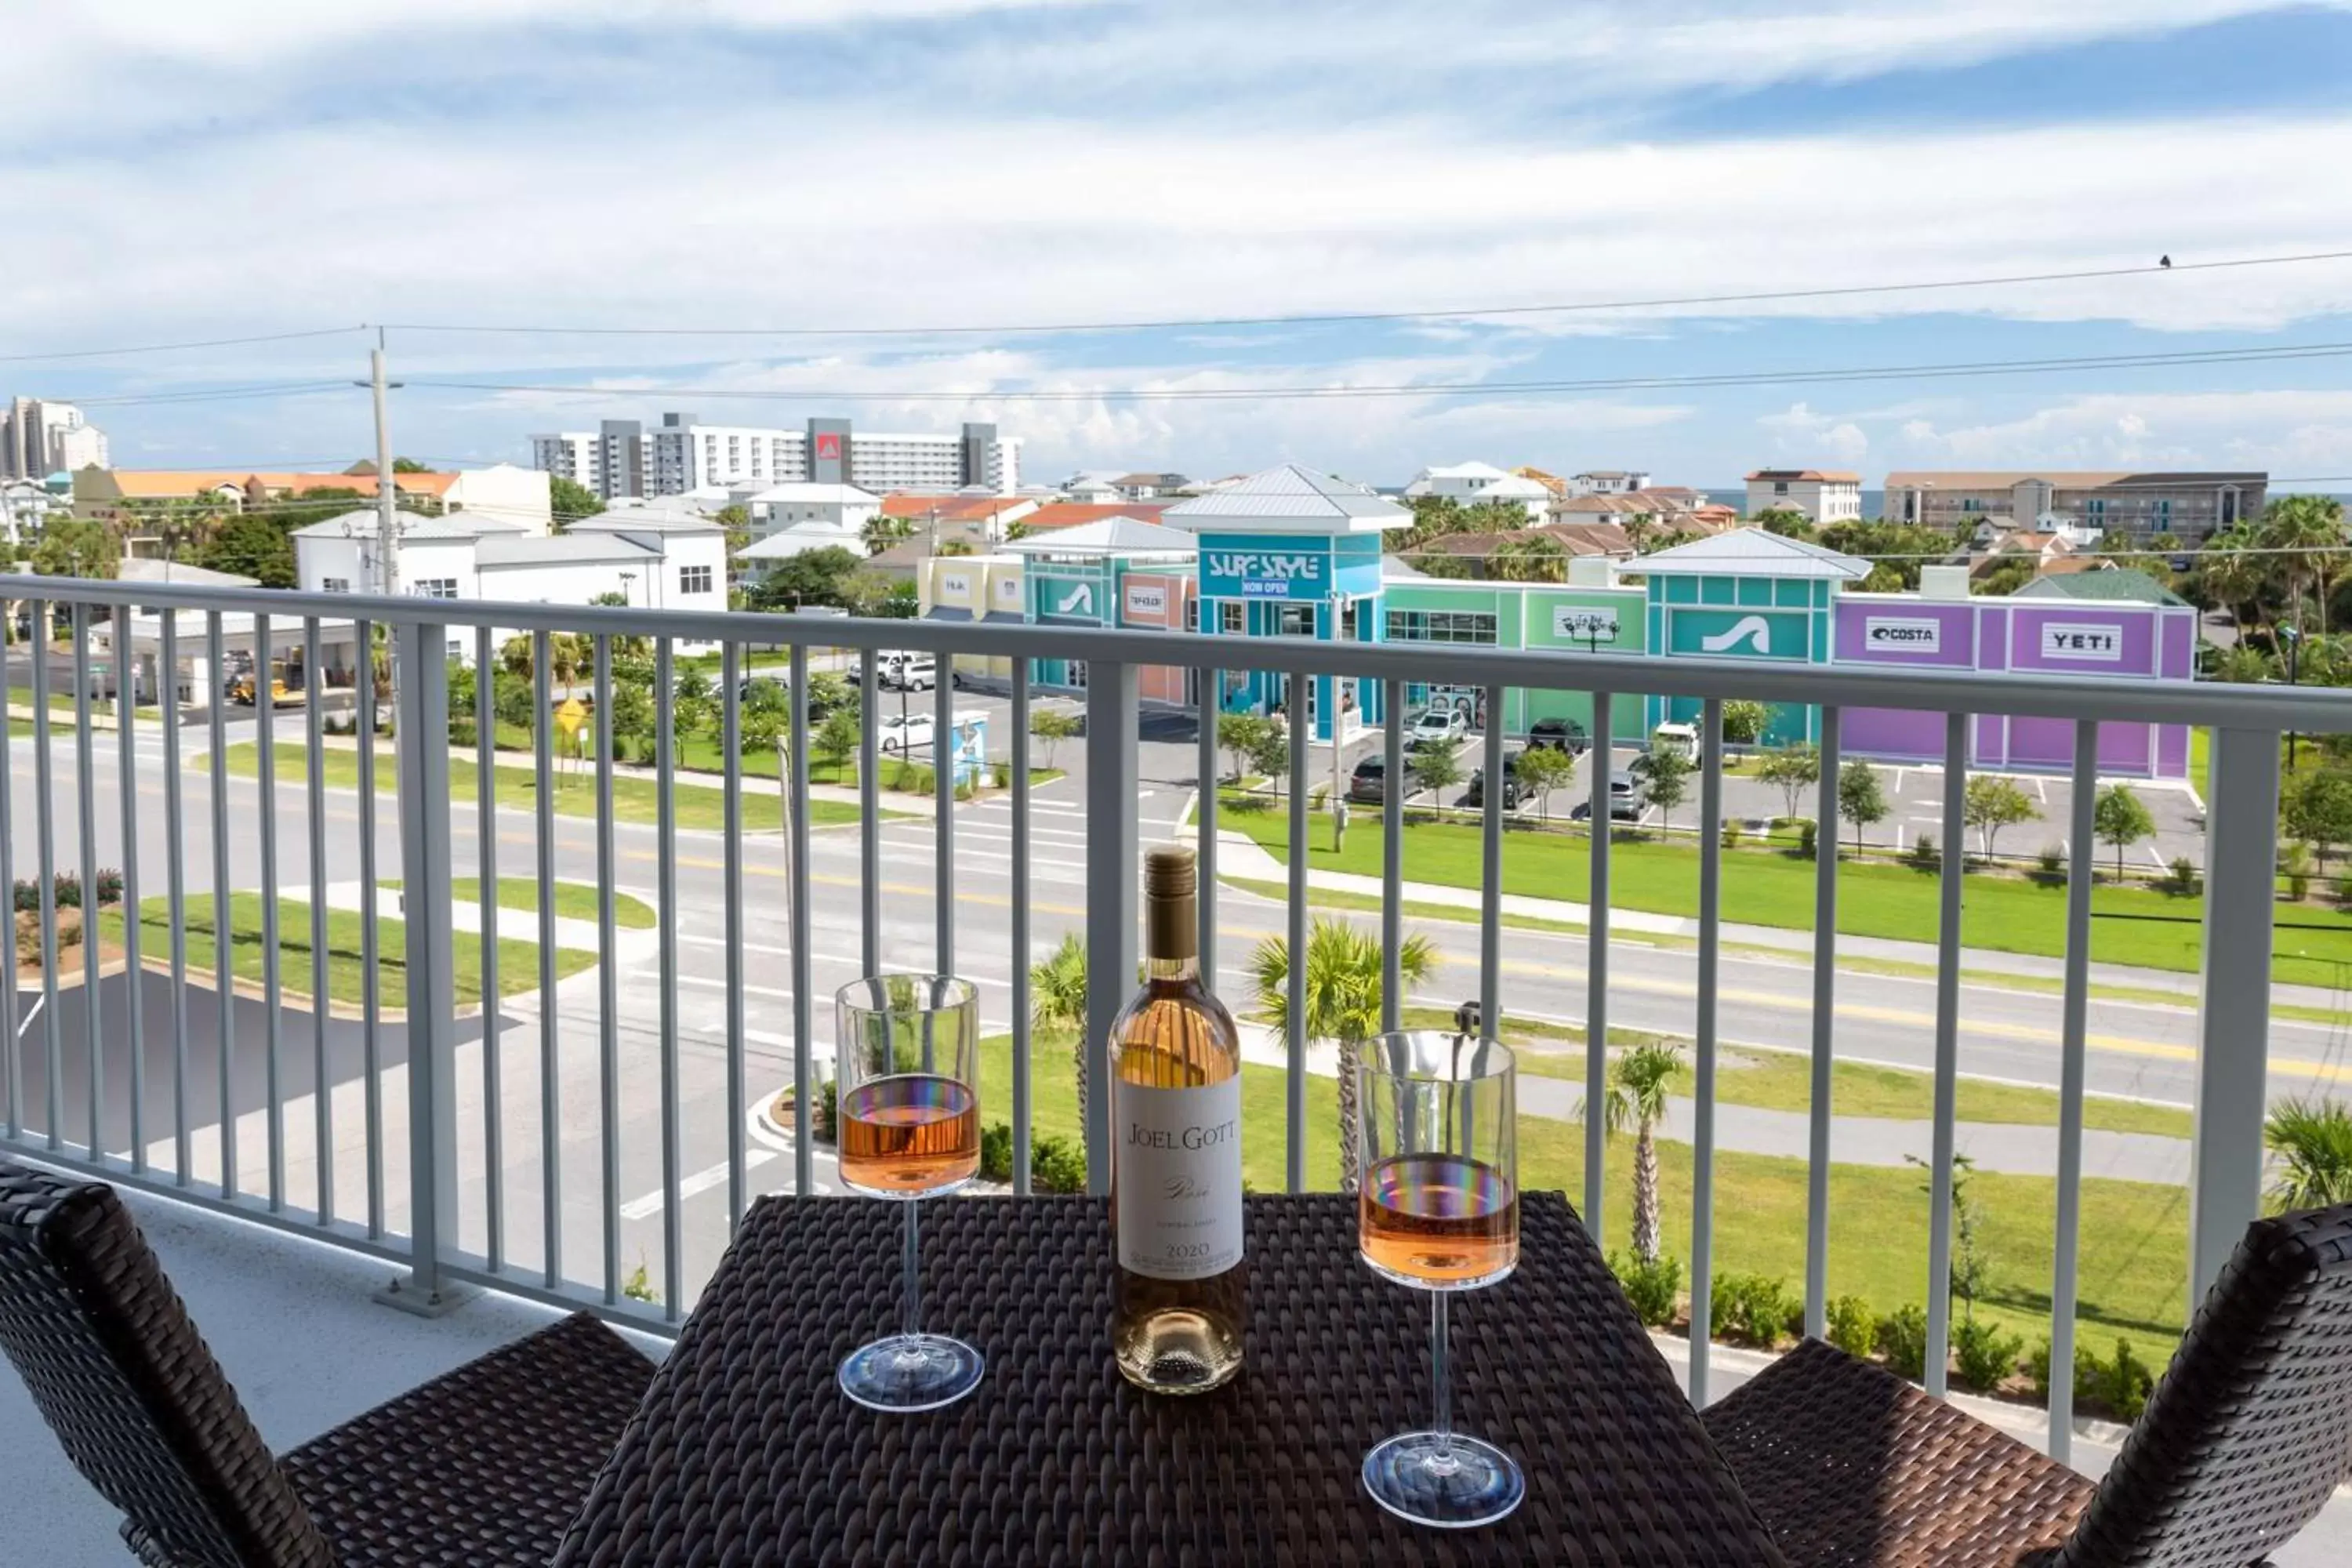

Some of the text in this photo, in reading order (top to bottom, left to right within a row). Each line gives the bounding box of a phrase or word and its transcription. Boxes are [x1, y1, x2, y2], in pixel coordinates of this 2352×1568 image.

[1243, 581, 1288, 593] NOW OPEN
[1890, 628, 1933, 641] COSTA
[2053, 633, 2112, 650] YETI
[1166, 1242, 1210, 1258] 2020
